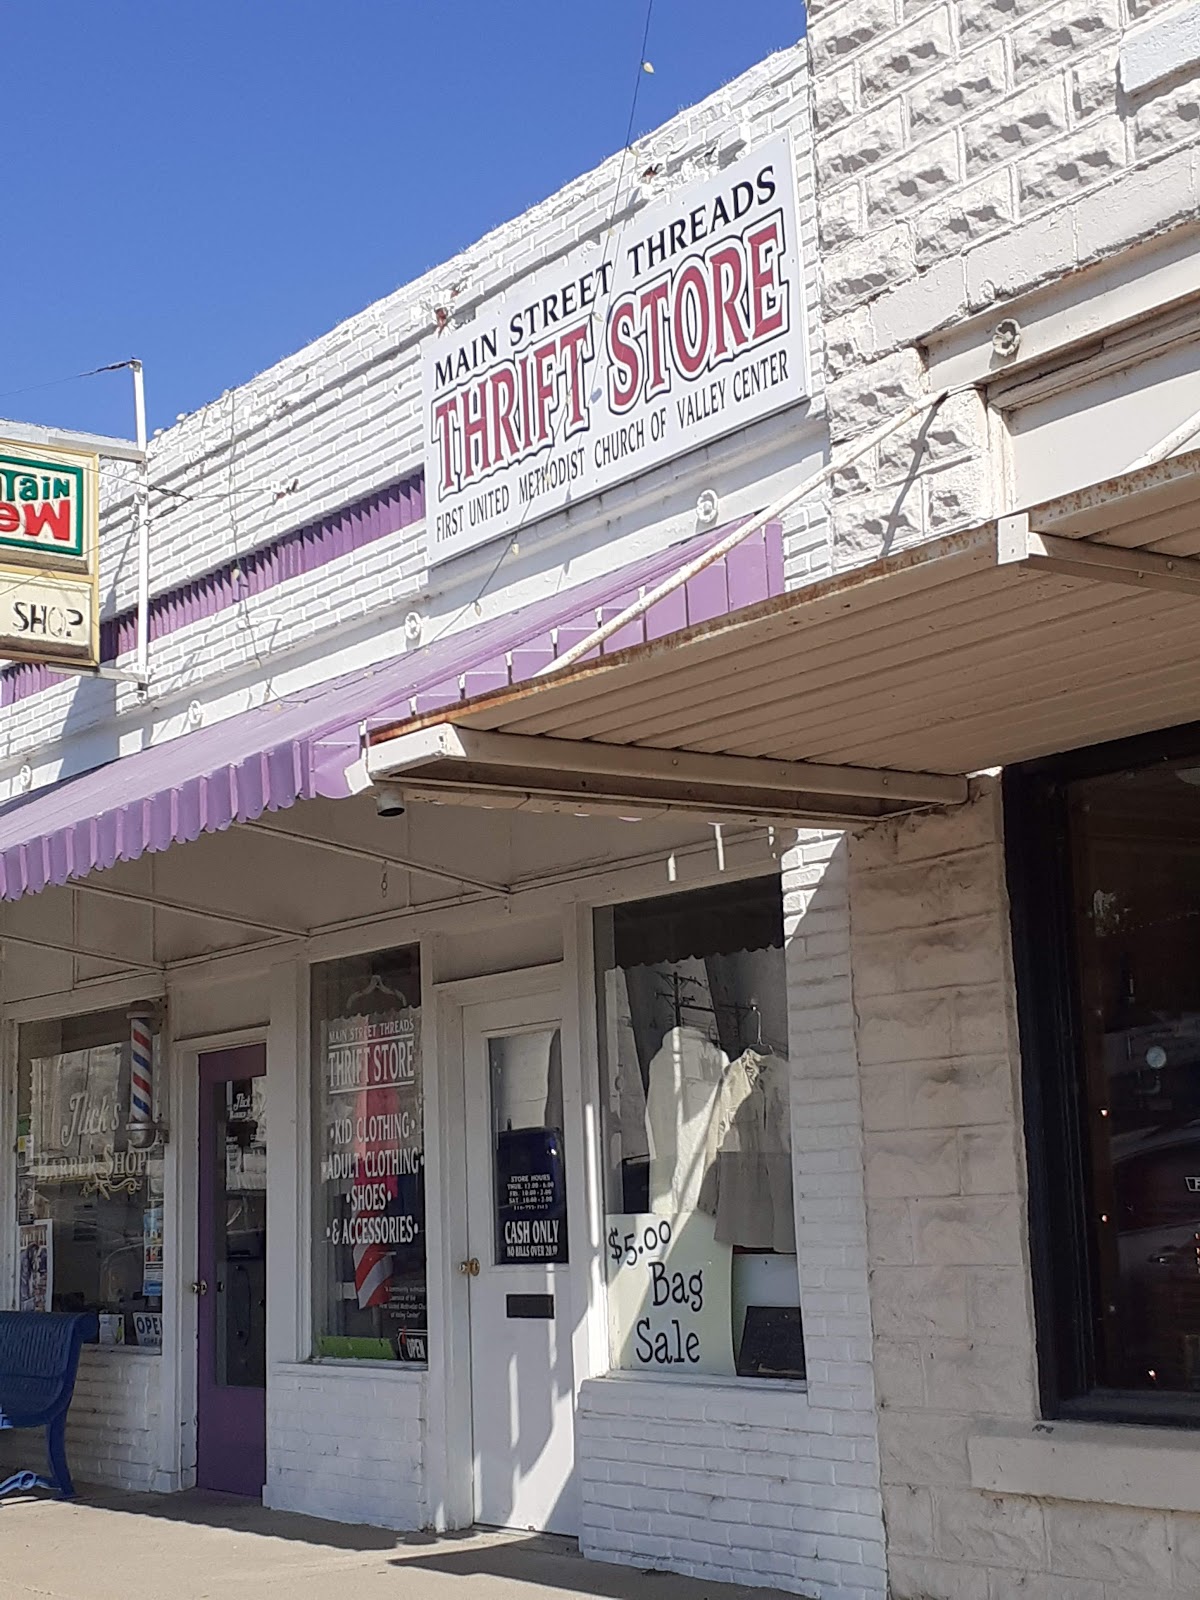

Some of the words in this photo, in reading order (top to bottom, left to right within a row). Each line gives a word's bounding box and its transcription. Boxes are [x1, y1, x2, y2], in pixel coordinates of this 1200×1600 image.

[434, 327, 498, 391] MAIN
[509, 261, 613, 346] STREET
[627, 165, 776, 278] THREADS
[432, 316, 594, 500] THRIFT
[607, 208, 789, 414] STORE
[436, 504, 464, 543] FIRST
[468, 486, 509, 528] UNITED
[518, 446, 586, 504] METHODIST
[594, 421, 645, 468] CHURCH
[650, 407, 667, 442] OF
[677, 382, 727, 429] VALLEY
[733, 350, 789, 412] CENTER
[329, 1030, 348, 1043] MAIN
[349, 1024, 377, 1041] STREET
[379, 1018, 414, 1036] THREADS
[329, 1047, 370, 1087] THRIFT
[374, 1040, 415, 1082] STORE
[335, 1118, 352, 1144] KID
[356, 1111, 410, 1142] CLOTHING
[104, 1144, 146, 1178] SHOP
[327, 1153, 360, 1179] ADULT
[364, 1147, 419, 1177] CLOTHING
[351, 1183, 386, 1211] SHOES
[332, 1218, 340, 1245] &
[341, 1215, 414, 1245] ACCESSORIES
[504, 1220, 530, 1245] CASH
[532, 1219, 559, 1244] ONLY
[608, 1221, 672, 1266] $5.00
[530, 1245, 544, 1257] OVER
[648, 1261, 703, 1312] Bag
[137, 1316, 162, 1335] OPE
[636, 1317, 701, 1364] Sale
[406, 1337, 425, 1359] OPEN
